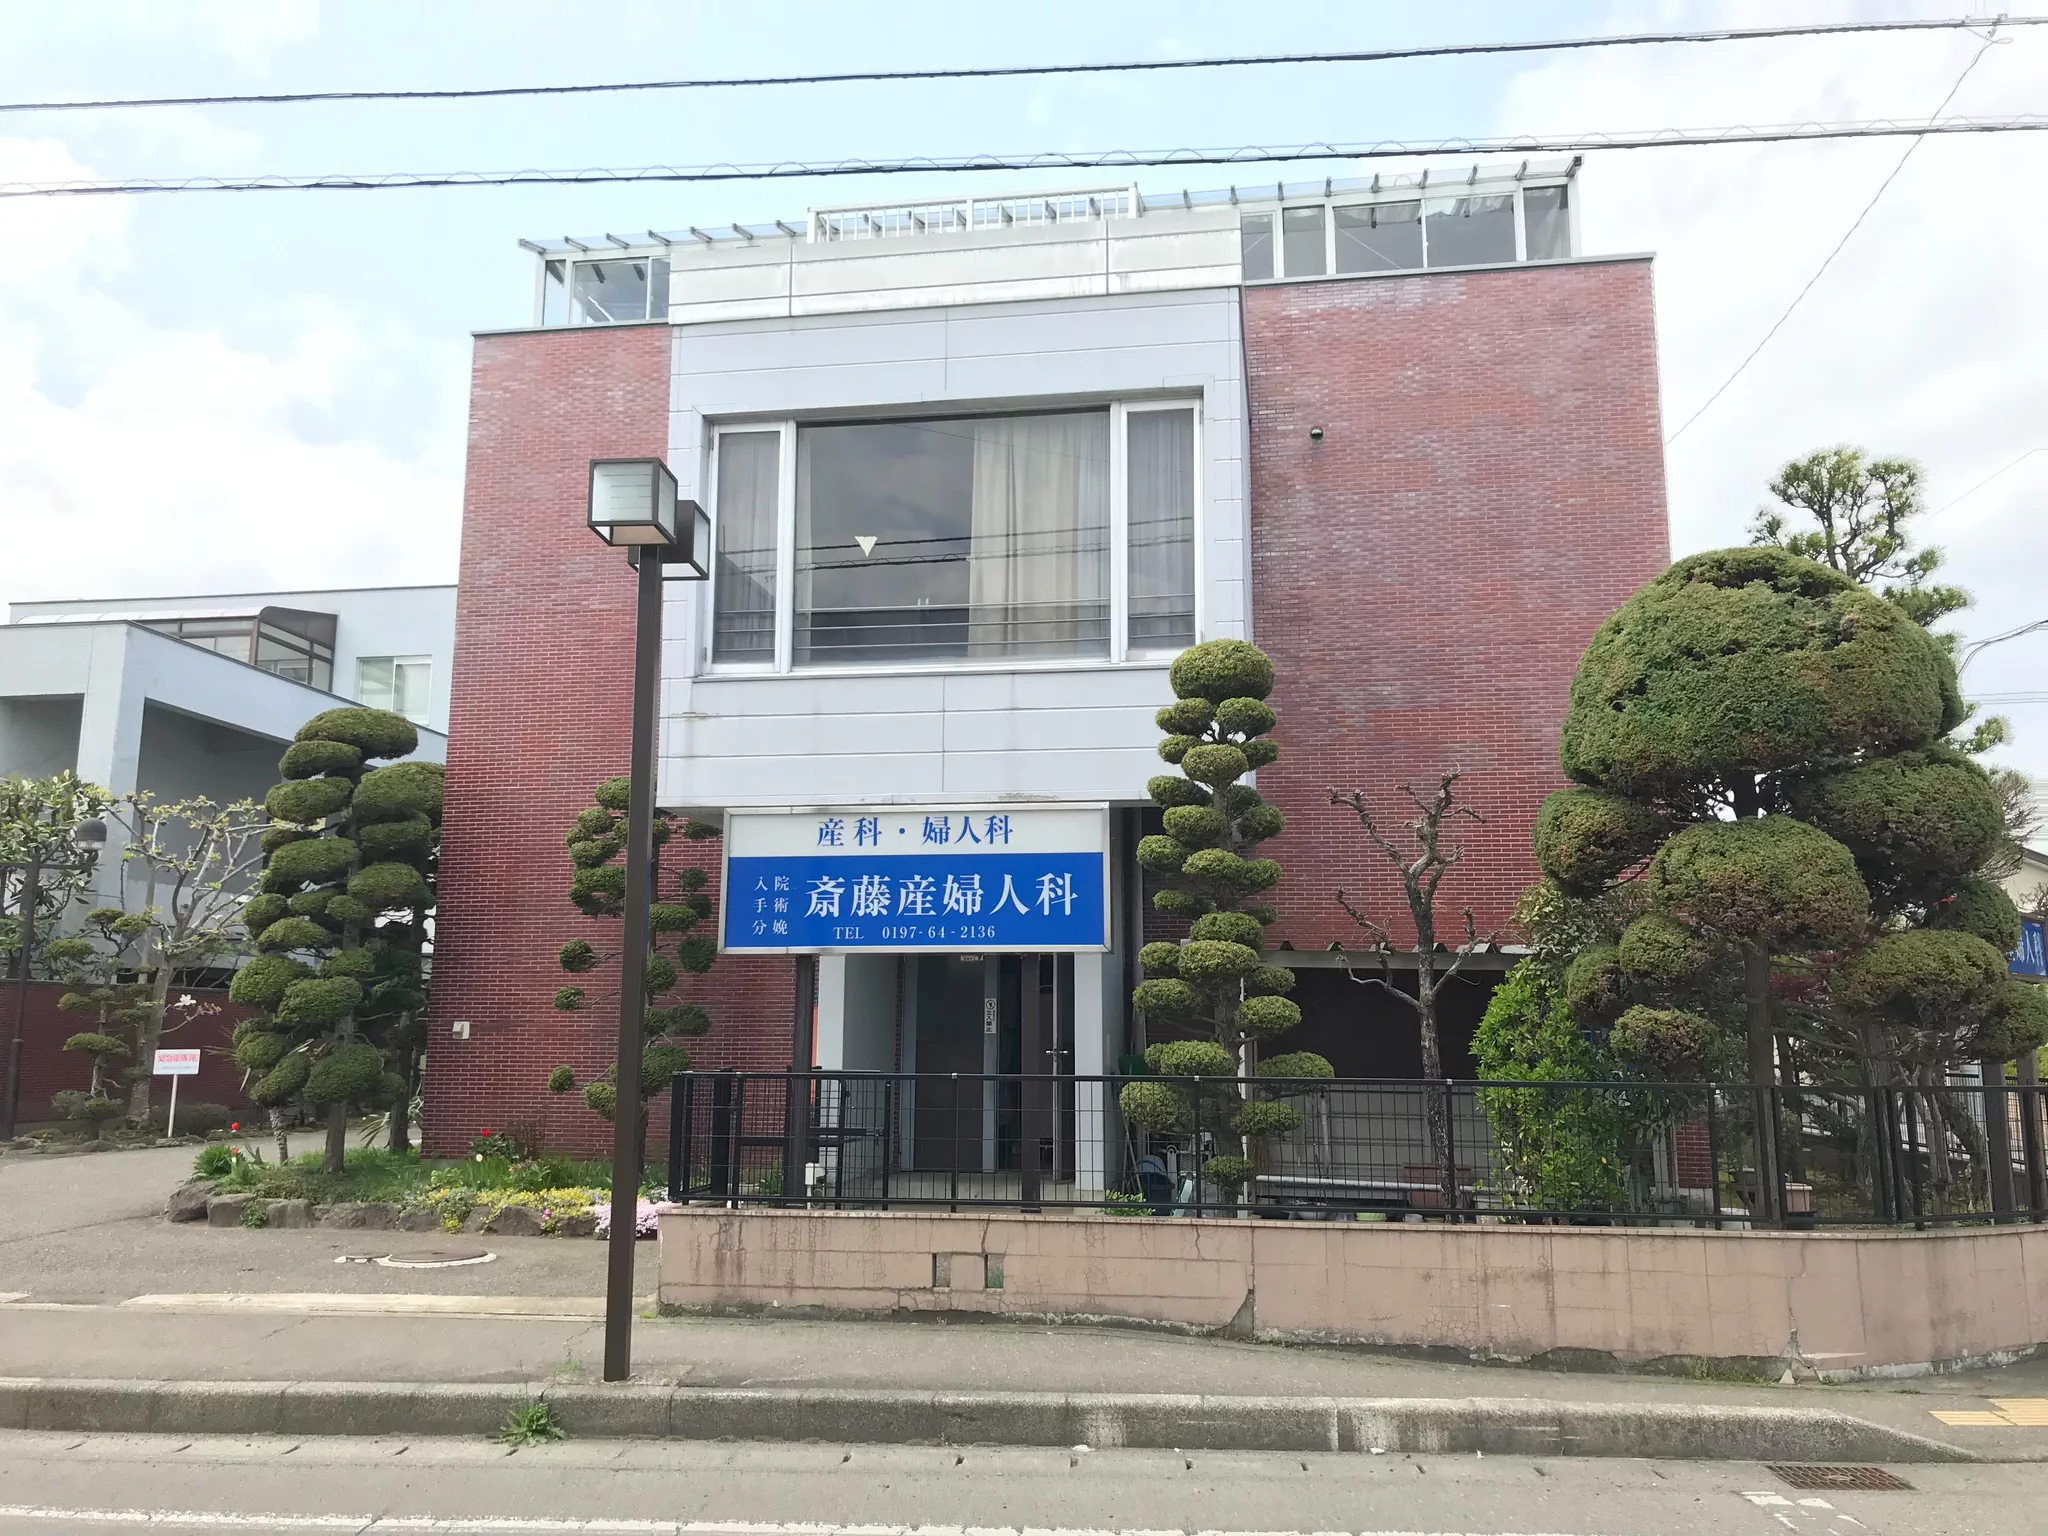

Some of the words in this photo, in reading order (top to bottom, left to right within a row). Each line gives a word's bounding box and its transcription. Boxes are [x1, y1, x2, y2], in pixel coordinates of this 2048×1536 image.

[816, 814, 1014, 847] 産科・婦人科
[754, 875, 790, 892] 入院
[803, 872, 1078, 918] 斎藤産婦人科
[753, 897, 789, 914] 手術
[752, 919, 788, 936] 分娩
[833, 926, 864, 940] TEL
[882, 925, 996, 940] 0197-64-2136
